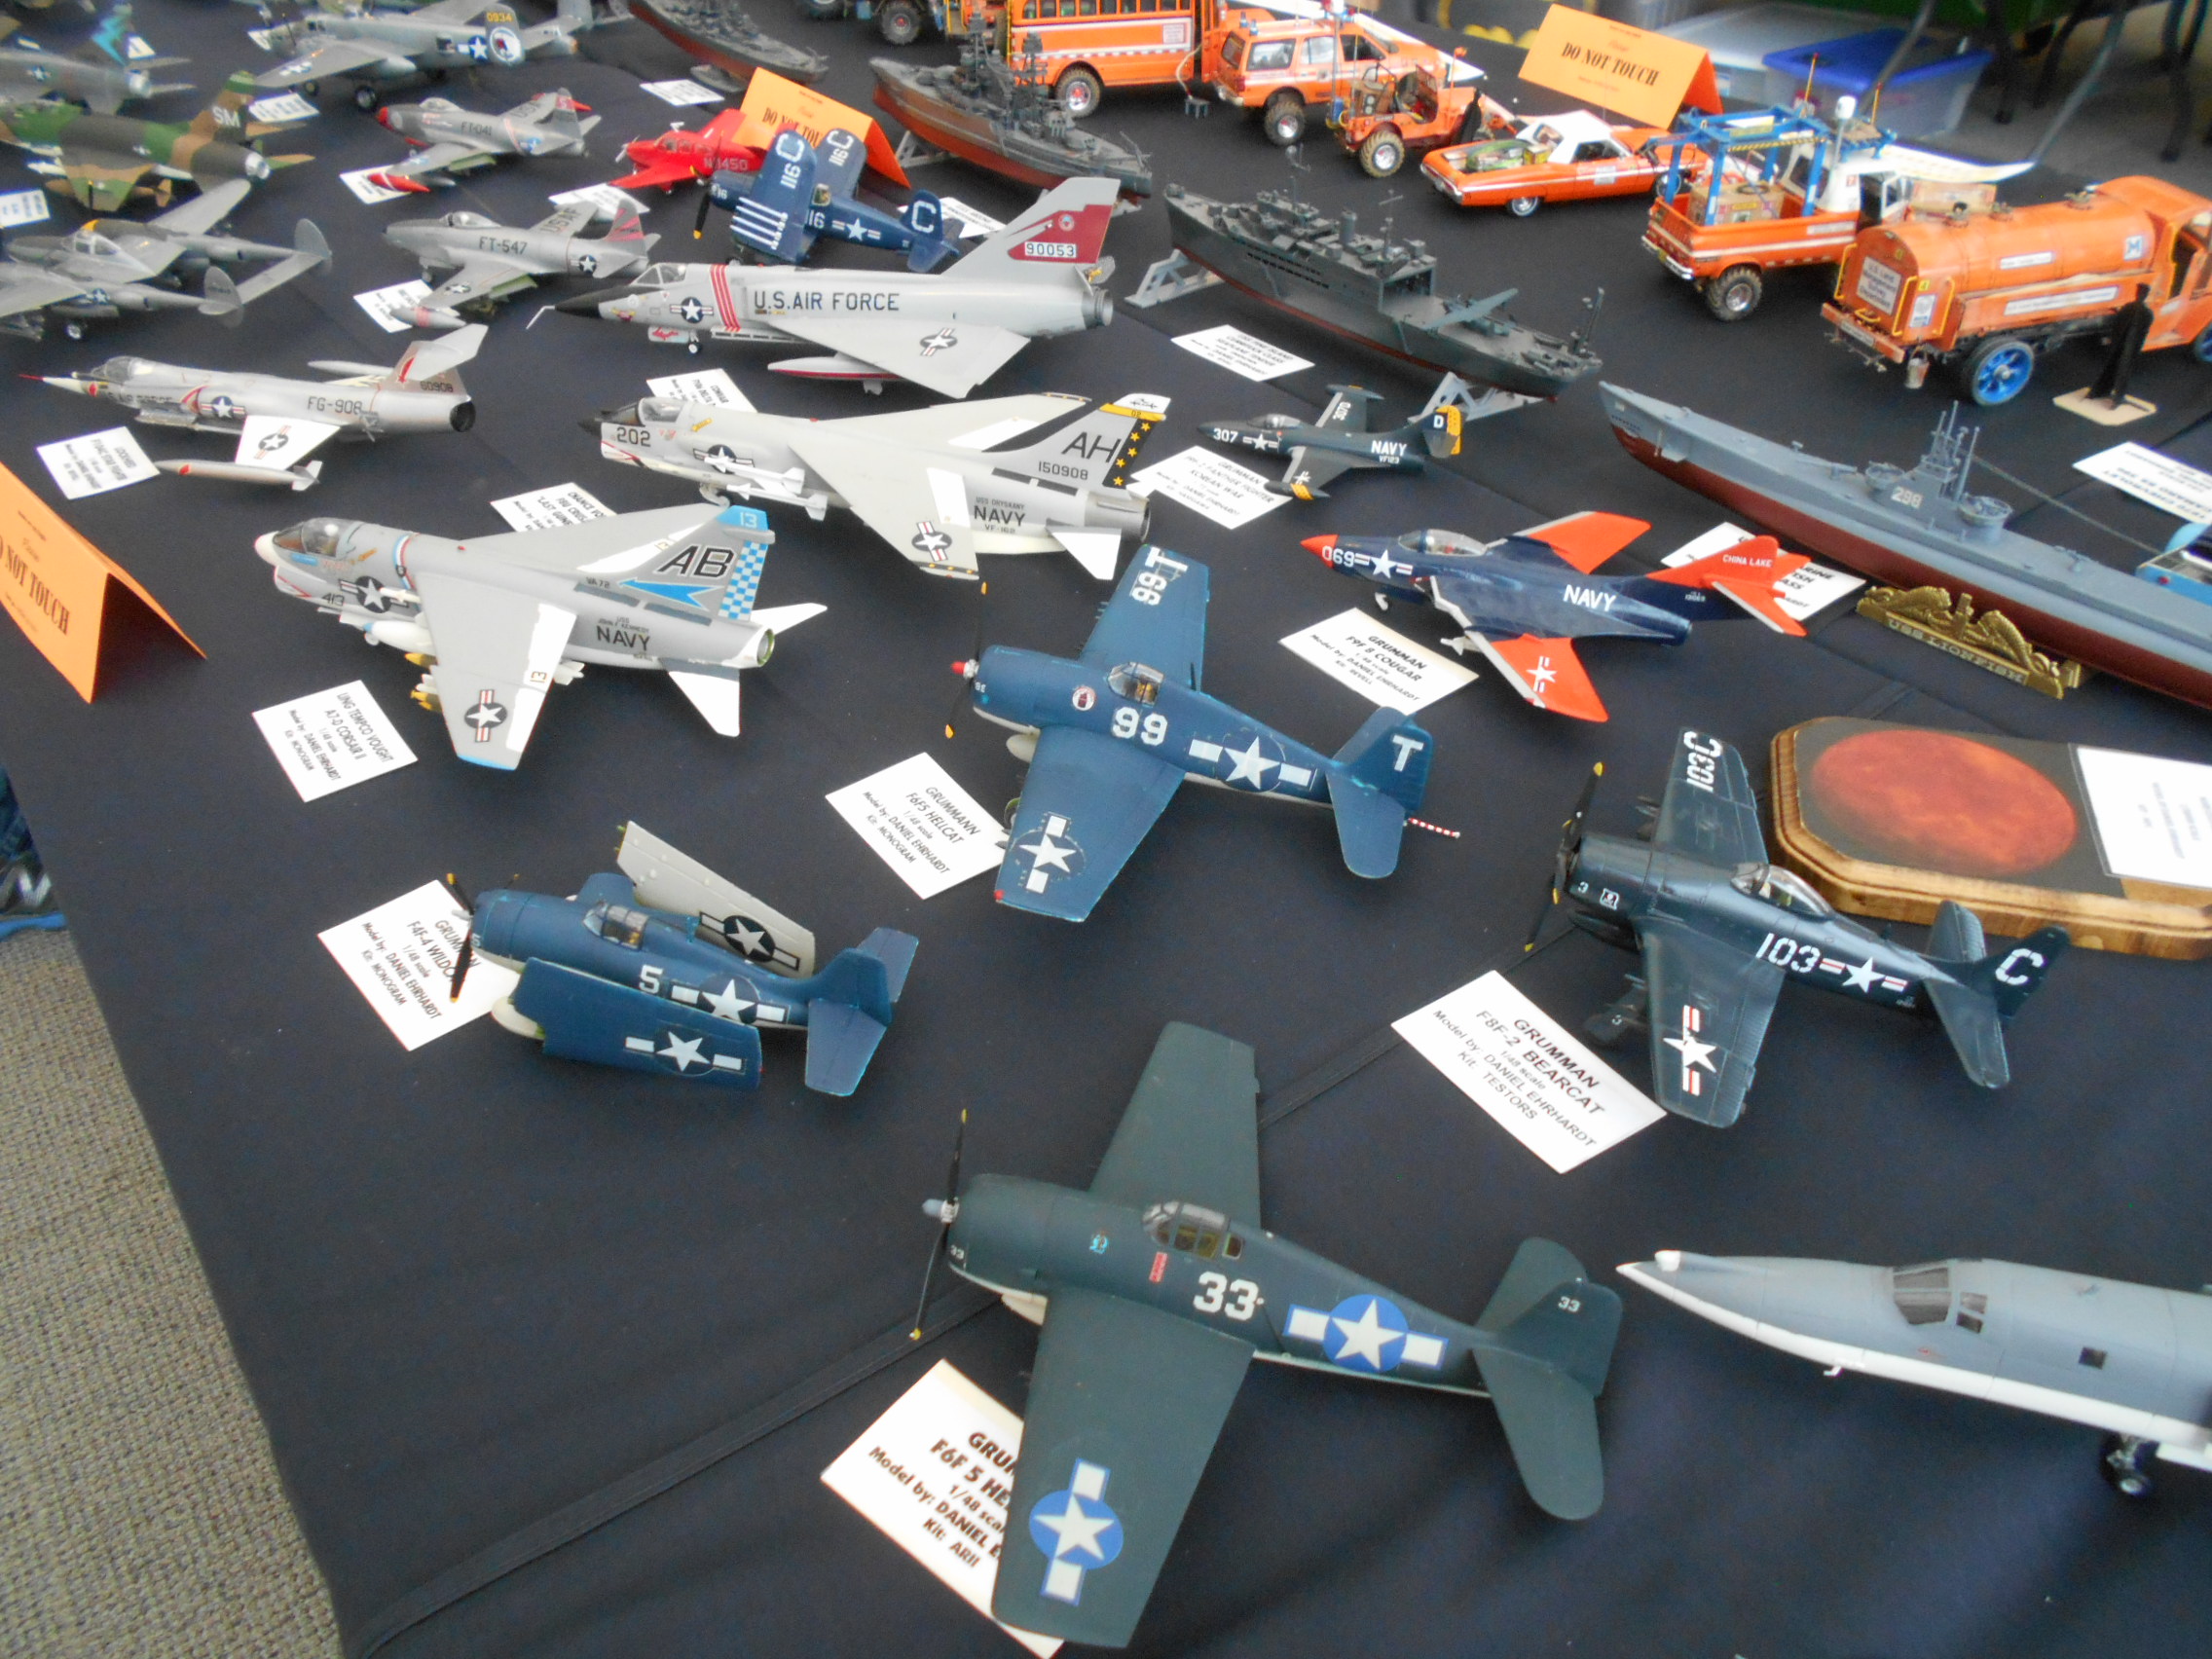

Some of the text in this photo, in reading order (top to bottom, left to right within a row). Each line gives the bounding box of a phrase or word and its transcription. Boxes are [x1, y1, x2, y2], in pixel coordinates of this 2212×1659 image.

[1561, 42, 1582, 61] DO
[1584, 49, 1611, 71] NOT
[1614, 58, 1661, 87] TOUCH
[212, 106, 241, 128] SM
[762, 107, 778, 127] DO
[800, 126, 824, 145] TOU
[703, 157, 749, 171] N1450
[808, 209, 827, 230] 16
[911, 199, 938, 234] C
[479, 236, 528, 255] FT-547
[1025, 242, 1076, 257] 90053
[832, 293, 901, 312] FORCE
[307, 395, 363, 416] FG-908
[1433, 415, 1445, 428] D
[616, 426, 651, 448] 202
[1060, 431, 1122, 463] AH
[1213, 427, 1238, 444] 307
[1371, 440, 1408, 456] NAVY
[1038, 461, 1089, 481] 150908
[739, 511, 758, 529] 13
[974, 504, 1026, 527] NAVY
[653, 544, 737, 580] AB
[1321, 545, 1355, 568] 069
[1722, 554, 1774, 569] CHINA LAKE
[6, 544, 28, 588] NOT
[29, 571, 70, 636] TOUCH
[321, 592, 345, 607] 413
[1563, 585, 1616, 611] NAVY
[596, 625, 650, 651] NAVY
[1310, 634, 1335, 652] Model
[1346, 657, 1377, 677] DANIEL
[1368, 635, 1428, 671] GRUMMAN
[1346, 635, 1367, 649] F9F
[1375, 652, 1423, 682] COUGAR
[1927, 635, 2025, 682] LIONFISH
[336, 725, 363, 756] CORSAIR
[1112, 705, 1168, 747] 99
[366, 734, 394, 762] VOUGHT
[1390, 734, 1424, 773] T
[903, 809, 934, 840] 1/48 scale
[924, 810, 965, 845] HELLCAT
[925, 787, 981, 836] GRUMMANN
[863, 791, 881, 809] Model
[888, 816, 916, 841] DANIEL
[911, 838, 951, 874] EHRHARDT
[877, 825, 917, 864] MONOGRAM
[1577, 881, 1589, 894] 3
[407, 920, 434, 946] F4F-4
[434, 919, 483, 969] GRUMN
[362, 922, 382, 942] Model
[385, 952, 412, 982] DANIEL
[405, 978, 443, 1019] EHRHARDT
[402, 943, 430, 978] 1/48 scale
[1754, 932, 1822, 974] 103
[1995, 947, 2046, 985] C
[371, 963, 408, 1007] MONOGRAM
[639, 965, 665, 994] 5
[1475, 1010, 1606, 1116] F8F-2 BEARCAT
[1499, 1050, 1547, 1090] 1/48 scale
[1513, 1017, 1602, 1089] GRUMMAN
[1432, 1009, 1465, 1040] Model
[1483, 1053, 1526, 1092] DANIEL
[1526, 1090, 1599, 1148] EHRHARDT
[1456, 1051, 1539, 1121] Kit: TESTORS
[949, 1244, 965, 1261] 33
[1193, 1271, 1260, 1321] 33
[1557, 1295, 1581, 1313] 33
[930, 1438, 970, 1470] F6F
[963, 1465, 985, 1484] 5
[867, 1446, 916, 1487] Model
[912, 1480, 938, 1505] by:
[934, 1499, 988, 1549] DANIEL
[948, 1484, 982, 1512] 1/48
[977, 1510, 1007, 1534] sca
[922, 1517, 948, 1542] Kit:
[949, 1539, 982, 1569] ARII
